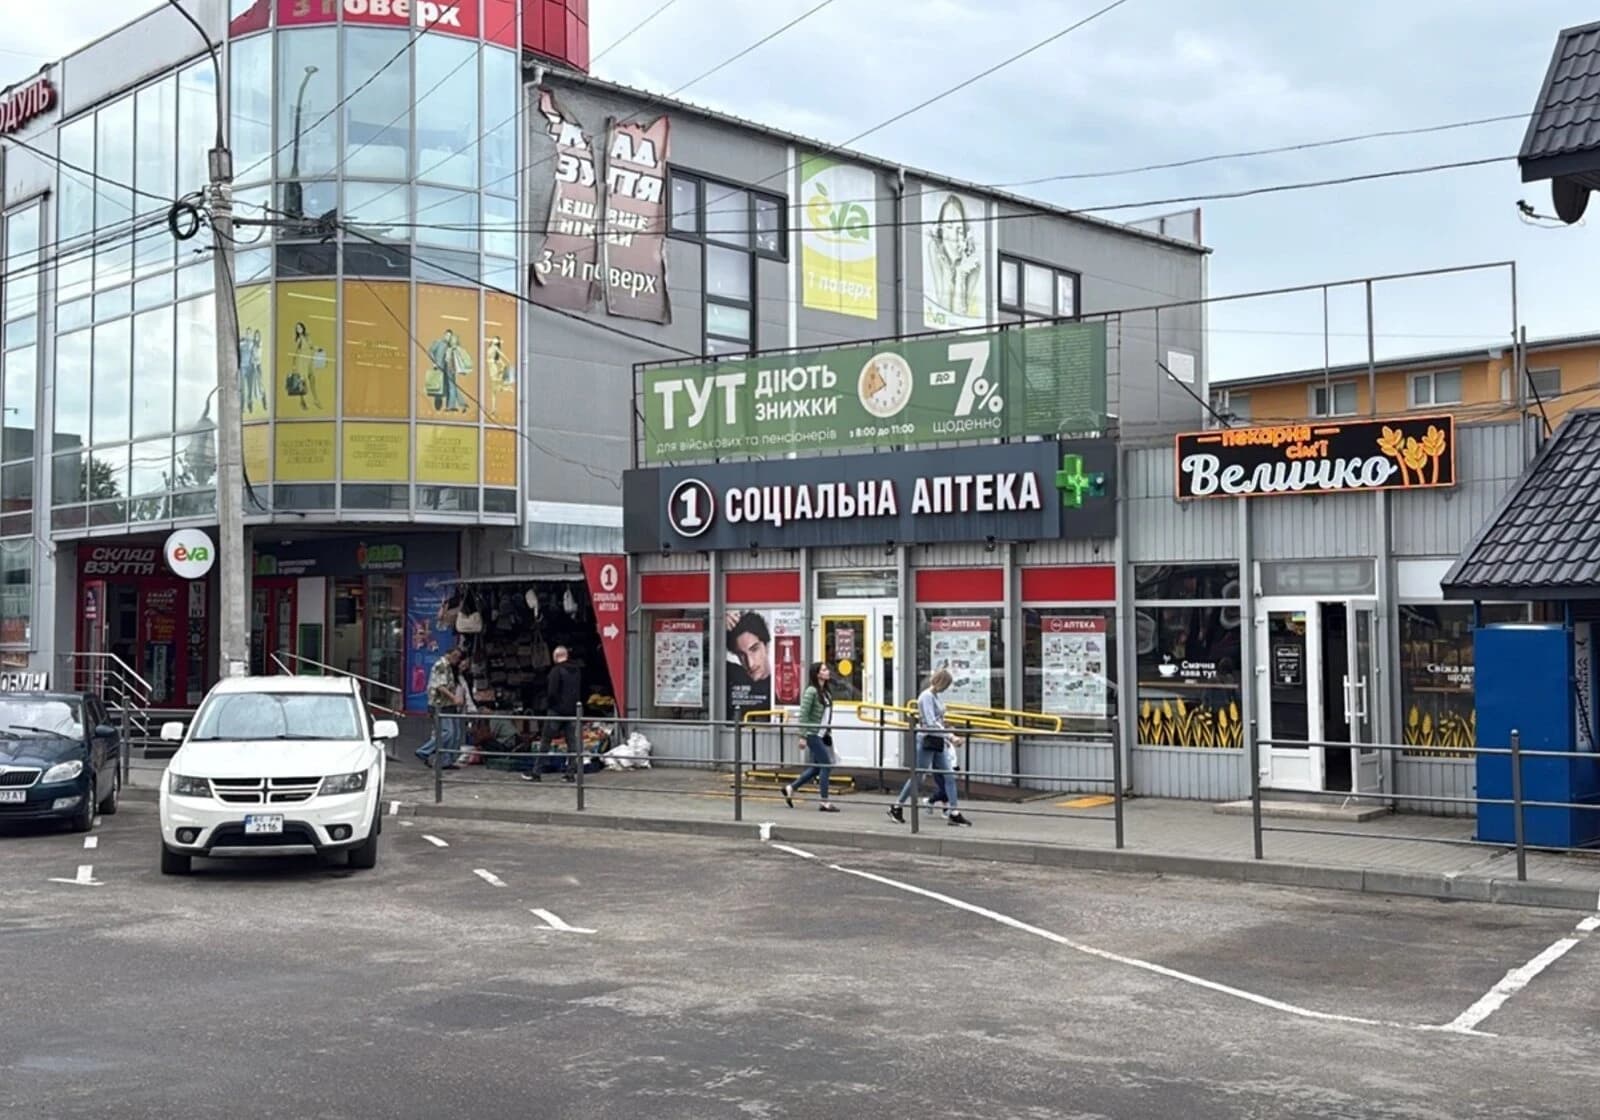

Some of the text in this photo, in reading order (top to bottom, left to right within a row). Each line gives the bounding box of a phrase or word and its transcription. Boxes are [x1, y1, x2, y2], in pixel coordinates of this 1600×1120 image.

[654, 365, 837, 430] ТУТ ДІЮТЬ
[855, 427, 876, 437] 8:00
[891, 423, 915, 435] 11:00
[933, 417, 1001, 433] щоденно
[656, 428, 837, 454] для військових та пенсіонерів
[1181, 453, 1398, 495] Величко
[679, 472, 1041, 527] 1 СОЦІАЛЬНА АПТЕКА
[92, 548, 156, 561] СКЛАД
[84, 561, 156, 575] ВЗУТТЯ
[951, 620, 981, 628] АПТЕКА
[1063, 621, 1096, 629] АПТЕКА
[1202, 670, 1217, 679] тут
